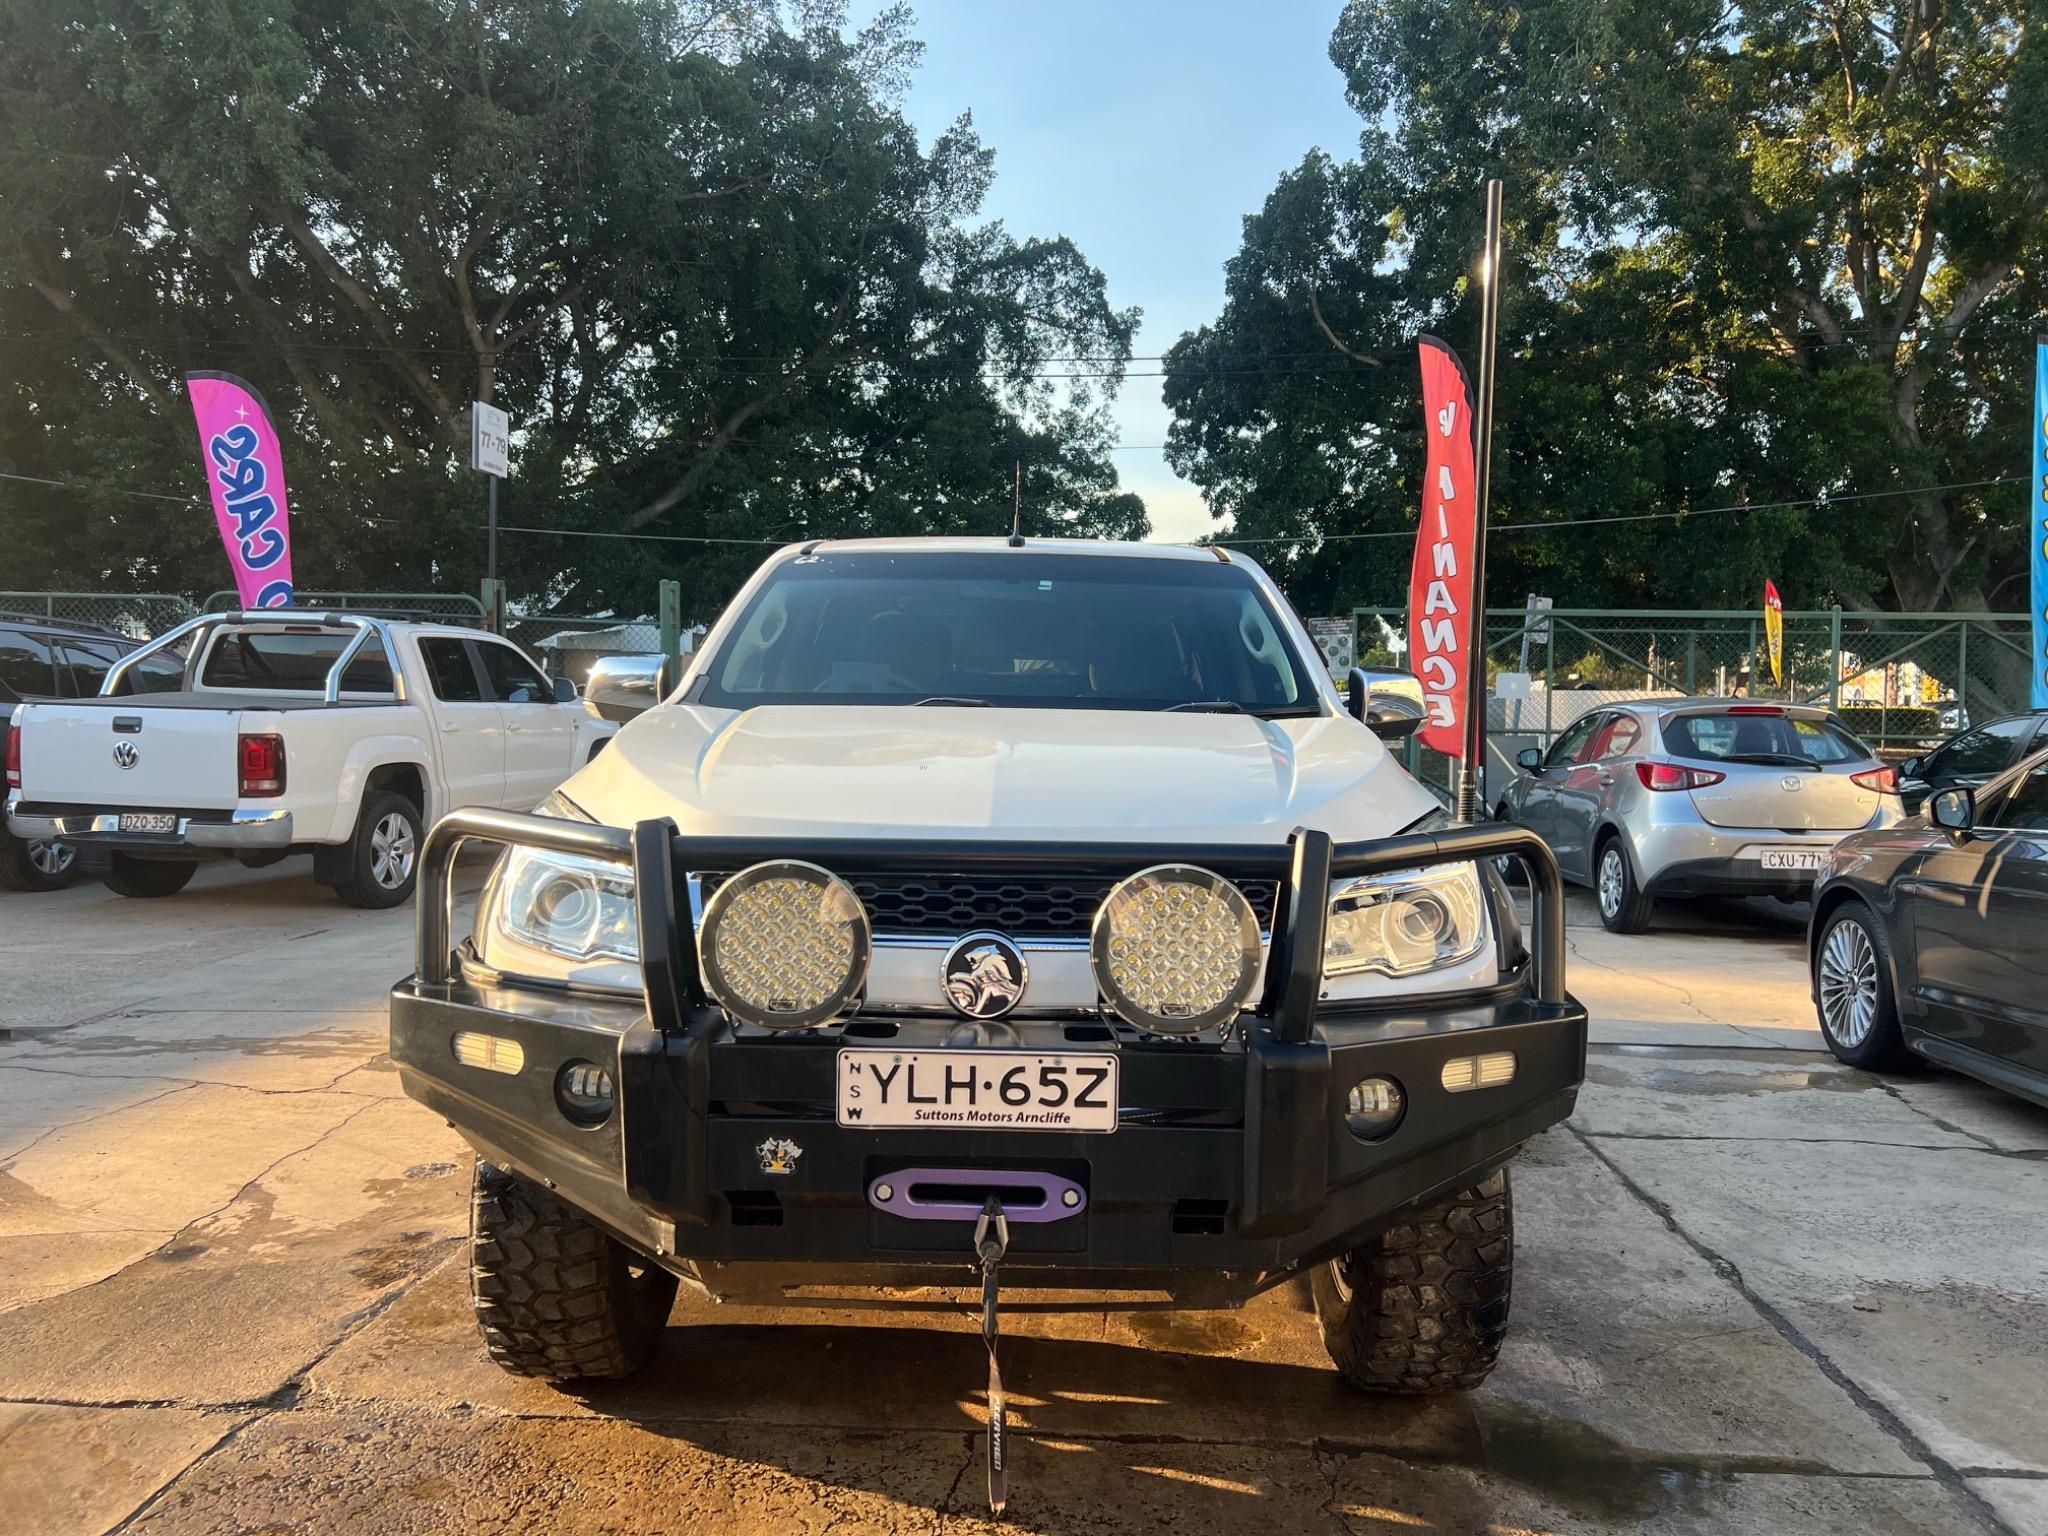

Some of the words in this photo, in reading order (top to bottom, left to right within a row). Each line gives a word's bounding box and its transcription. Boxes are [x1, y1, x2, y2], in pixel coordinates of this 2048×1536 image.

[914, 1109, 965, 1122] Suttons
[967, 1111, 1013, 1123] Motors
[1015, 1111, 1071, 1124] Arncliffe
